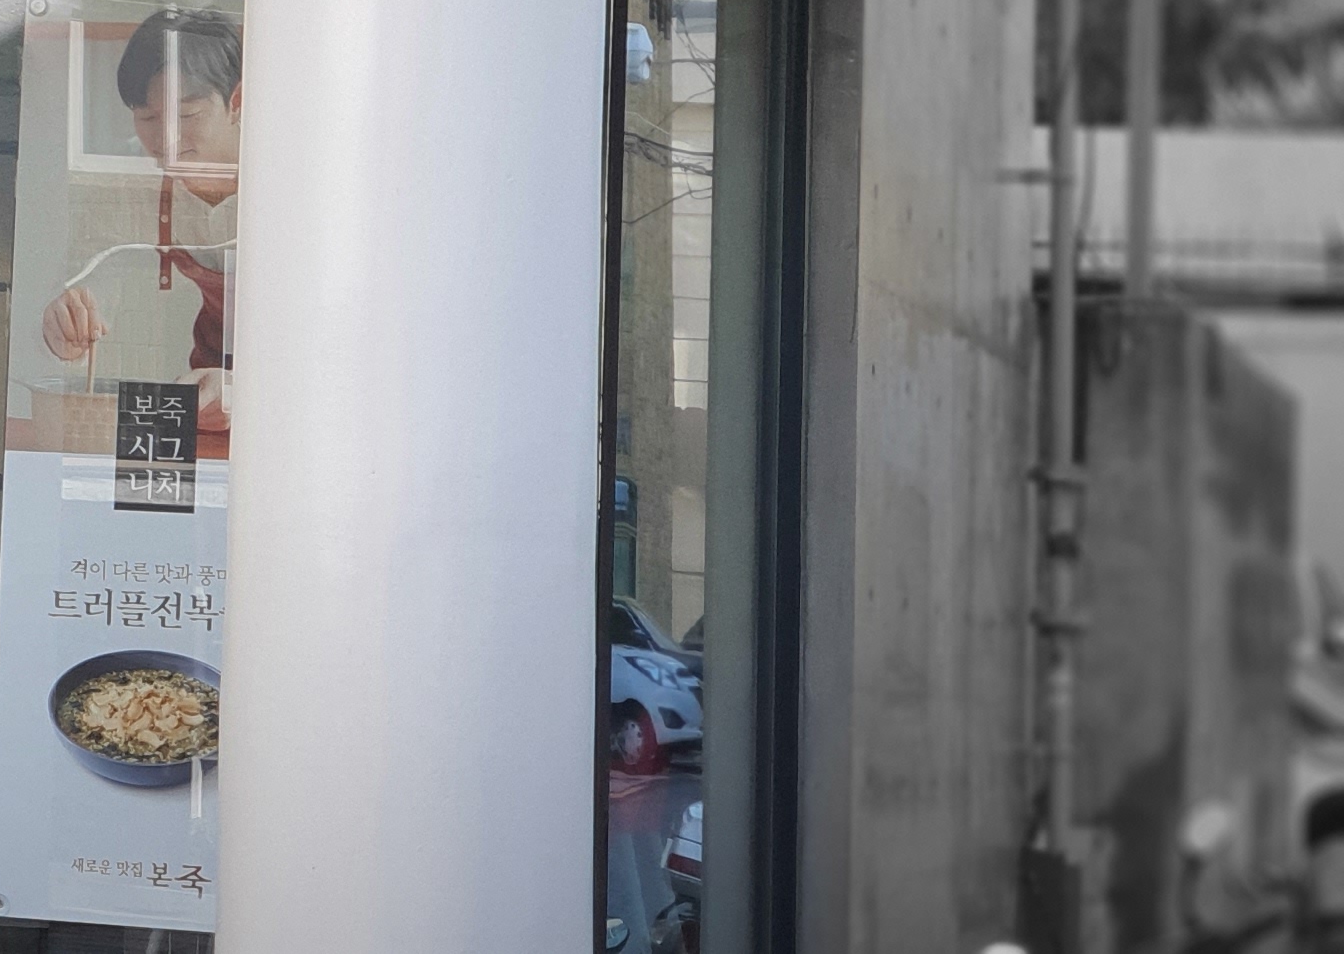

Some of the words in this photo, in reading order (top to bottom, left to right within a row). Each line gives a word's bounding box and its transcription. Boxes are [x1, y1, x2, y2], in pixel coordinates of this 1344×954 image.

[129, 394, 187, 428] 본죽
[128, 432, 185, 464] 시그
[128, 469, 181, 502] 니처
[70, 558, 106, 581] 격이
[113, 560, 150, 583] 다른
[155, 562, 193, 585] 맛과
[47, 587, 226, 632] 트러플전복
[70, 857, 113, 876] 새로운
[116, 860, 143, 878] 맛집
[146, 862, 213, 900] 본죽
